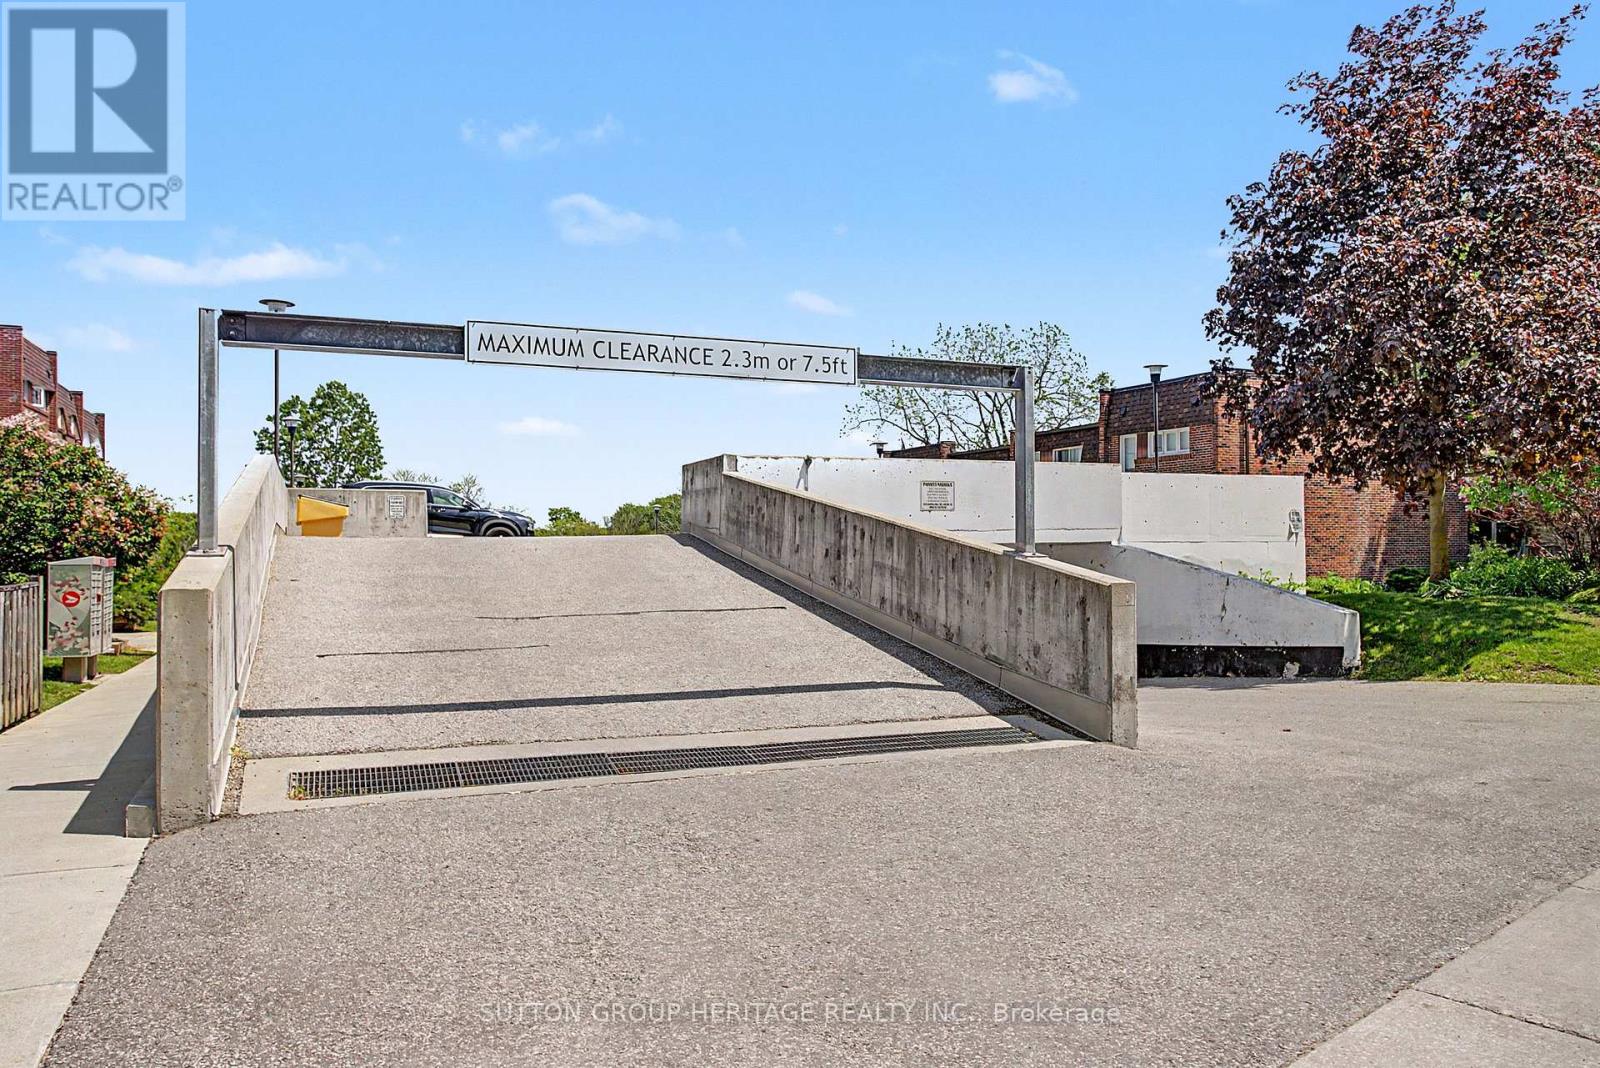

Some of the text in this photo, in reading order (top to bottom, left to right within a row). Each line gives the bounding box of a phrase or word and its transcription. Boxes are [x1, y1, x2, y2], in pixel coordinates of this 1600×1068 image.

[477, 332, 848, 375] MAXIMUM CLEARANCE 2.3m or 7.5ft
